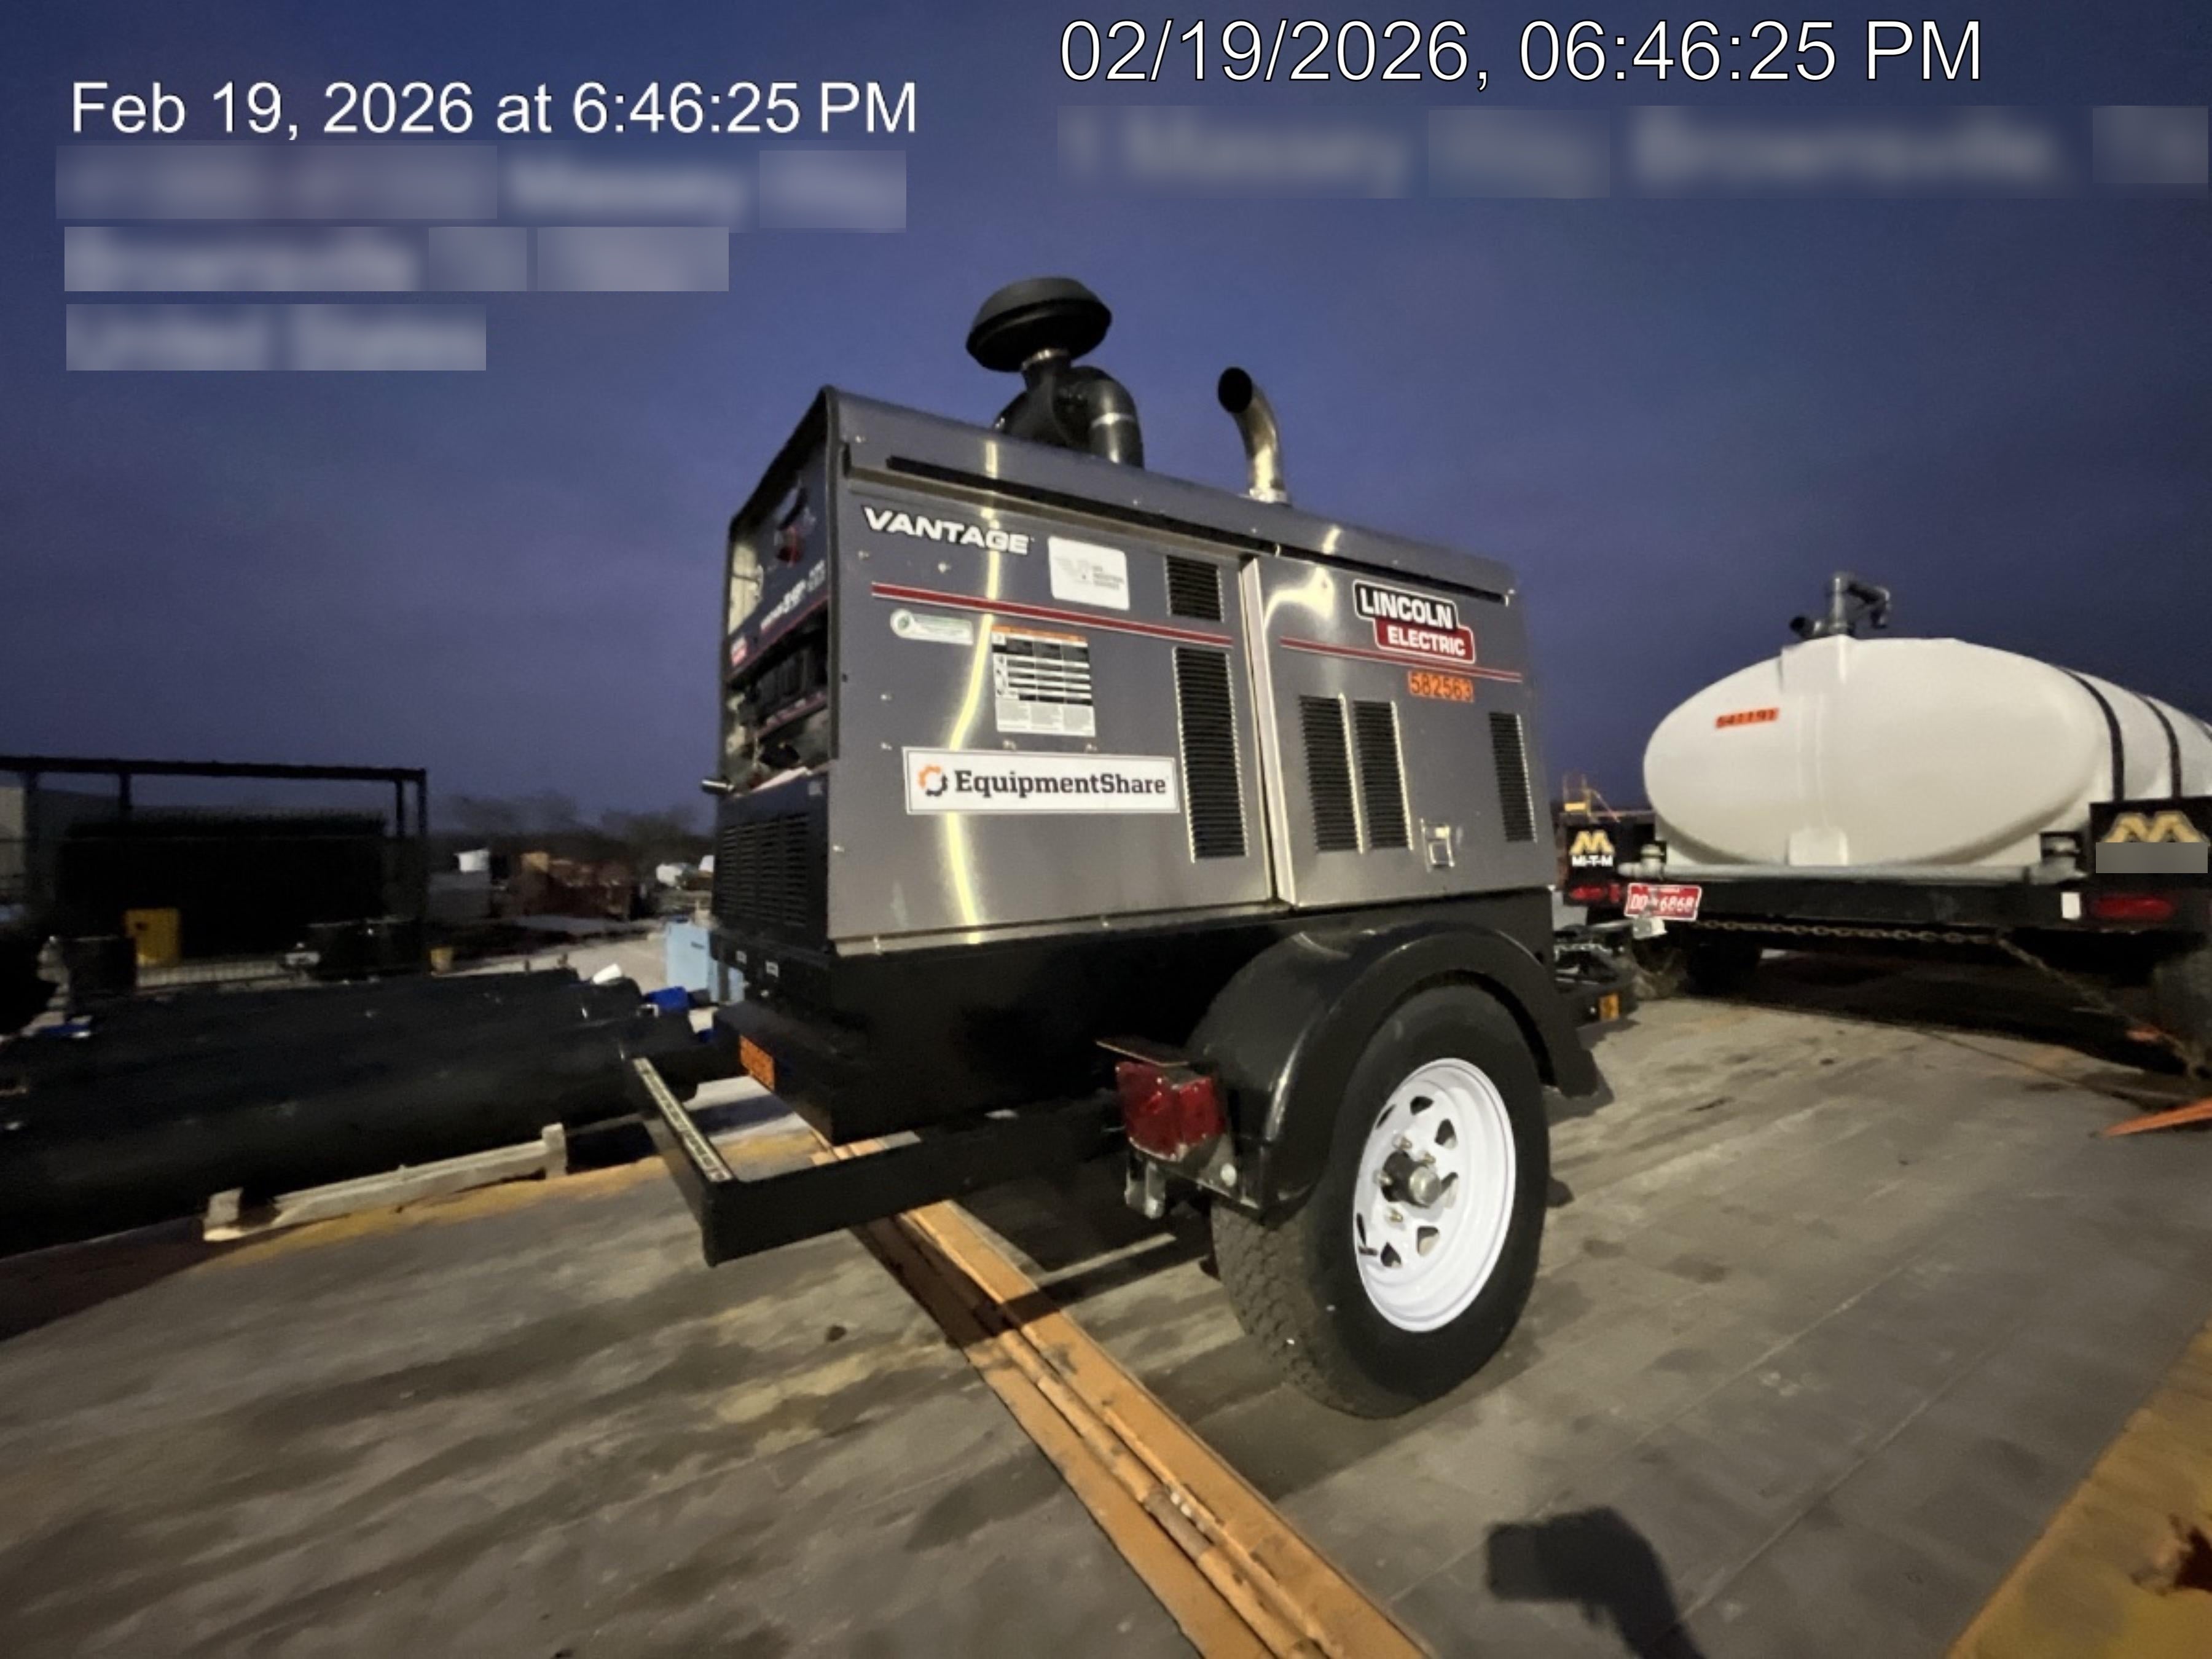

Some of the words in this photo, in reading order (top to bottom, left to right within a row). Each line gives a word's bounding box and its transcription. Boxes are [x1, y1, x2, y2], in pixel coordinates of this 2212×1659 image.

[863, 506, 1029, 555] VANTAGE
[1360, 587, 1454, 630] LINCOLN
[1387, 624, 1466, 657] ELECTRIC
[954, 769, 1166, 799] EquipmentShare
